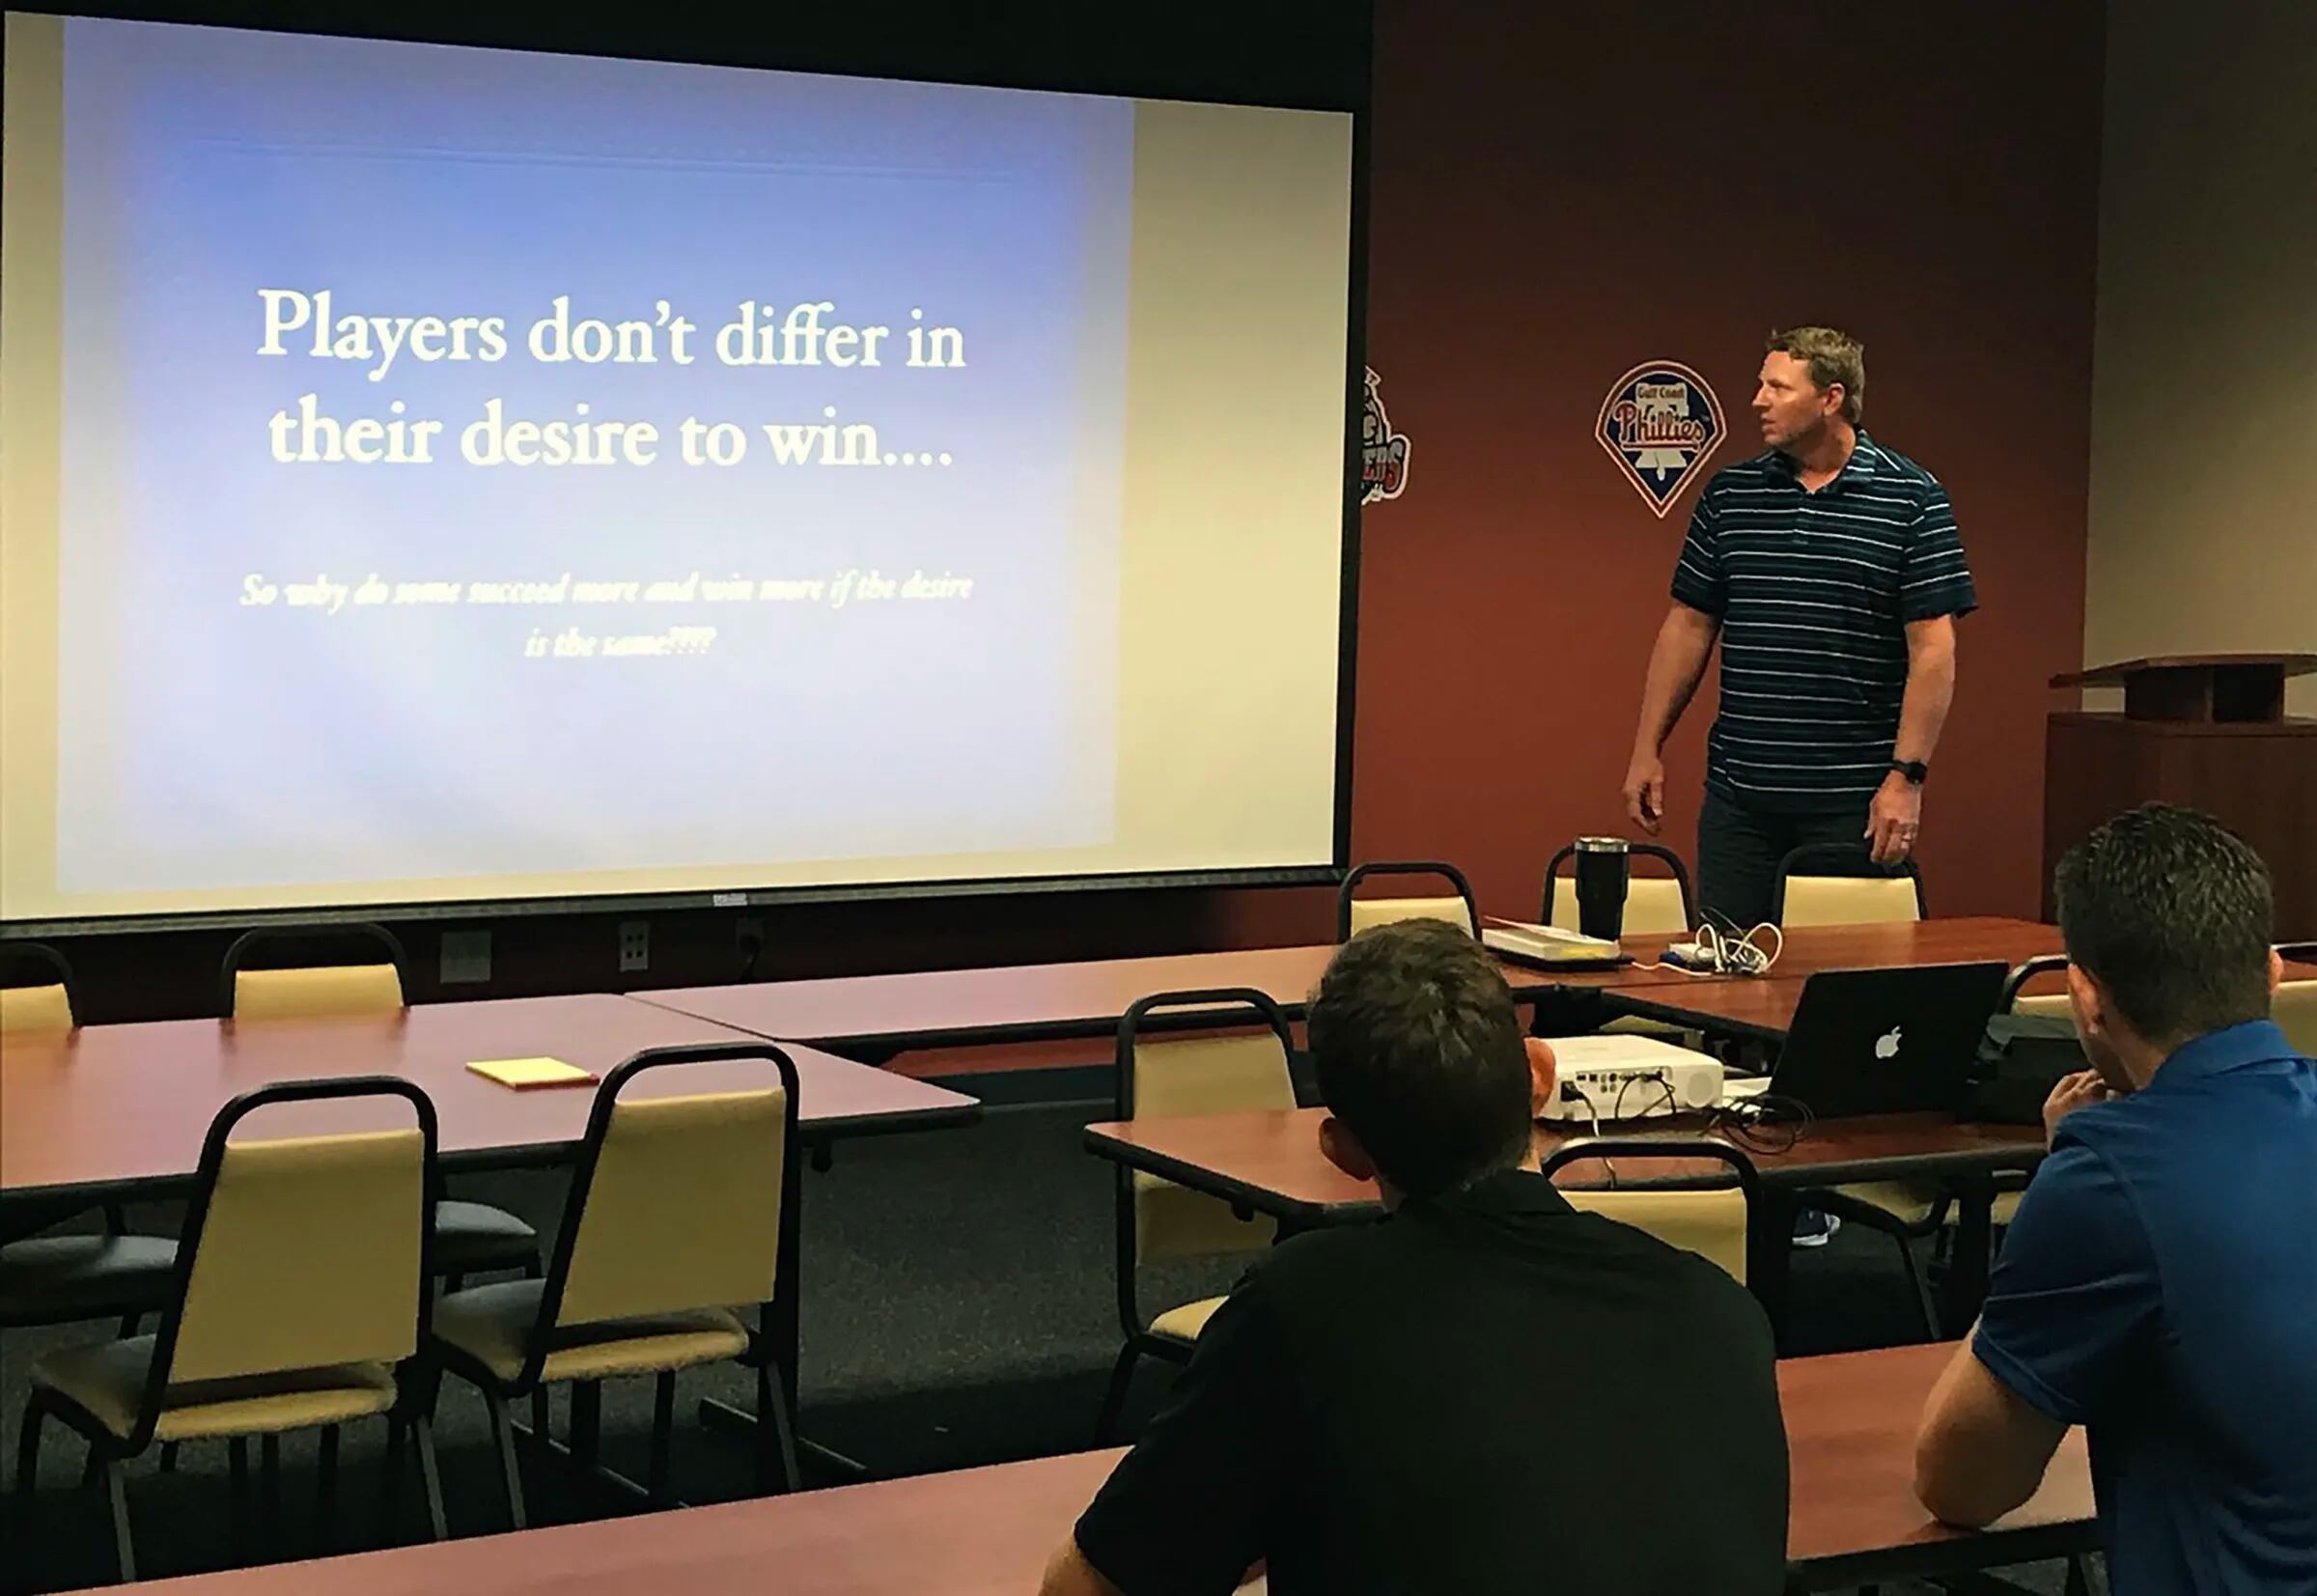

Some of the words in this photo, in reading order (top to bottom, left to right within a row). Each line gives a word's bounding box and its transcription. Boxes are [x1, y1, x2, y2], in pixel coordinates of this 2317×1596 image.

[256, 289, 508, 382] Players
[528, 294, 696, 364] don’t
[715, 300, 889, 368] differ
[906, 307, 967, 368] in
[268, 392, 443, 463] their
[460, 398, 659, 465] desire
[680, 416, 747, 466] to
[762, 406, 952, 466] win....
[1613, 401, 1705, 443] Phillies
[239, 574, 278, 605] So
[284, 574, 349, 615] why
[353, 573, 389, 604] do
[392, 582, 461, 604] some
[465, 573, 571, 603] succeed
[572, 581, 639, 602] more
[644, 572, 699, 602] and
[701, 572, 754, 602] win
[759, 580, 824, 601] more
[829, 569, 858, 609] if
[856, 570, 897, 600] the
[900, 570, 974, 600] desire
[524, 628, 548, 658] is
[553, 627, 597, 658] the
